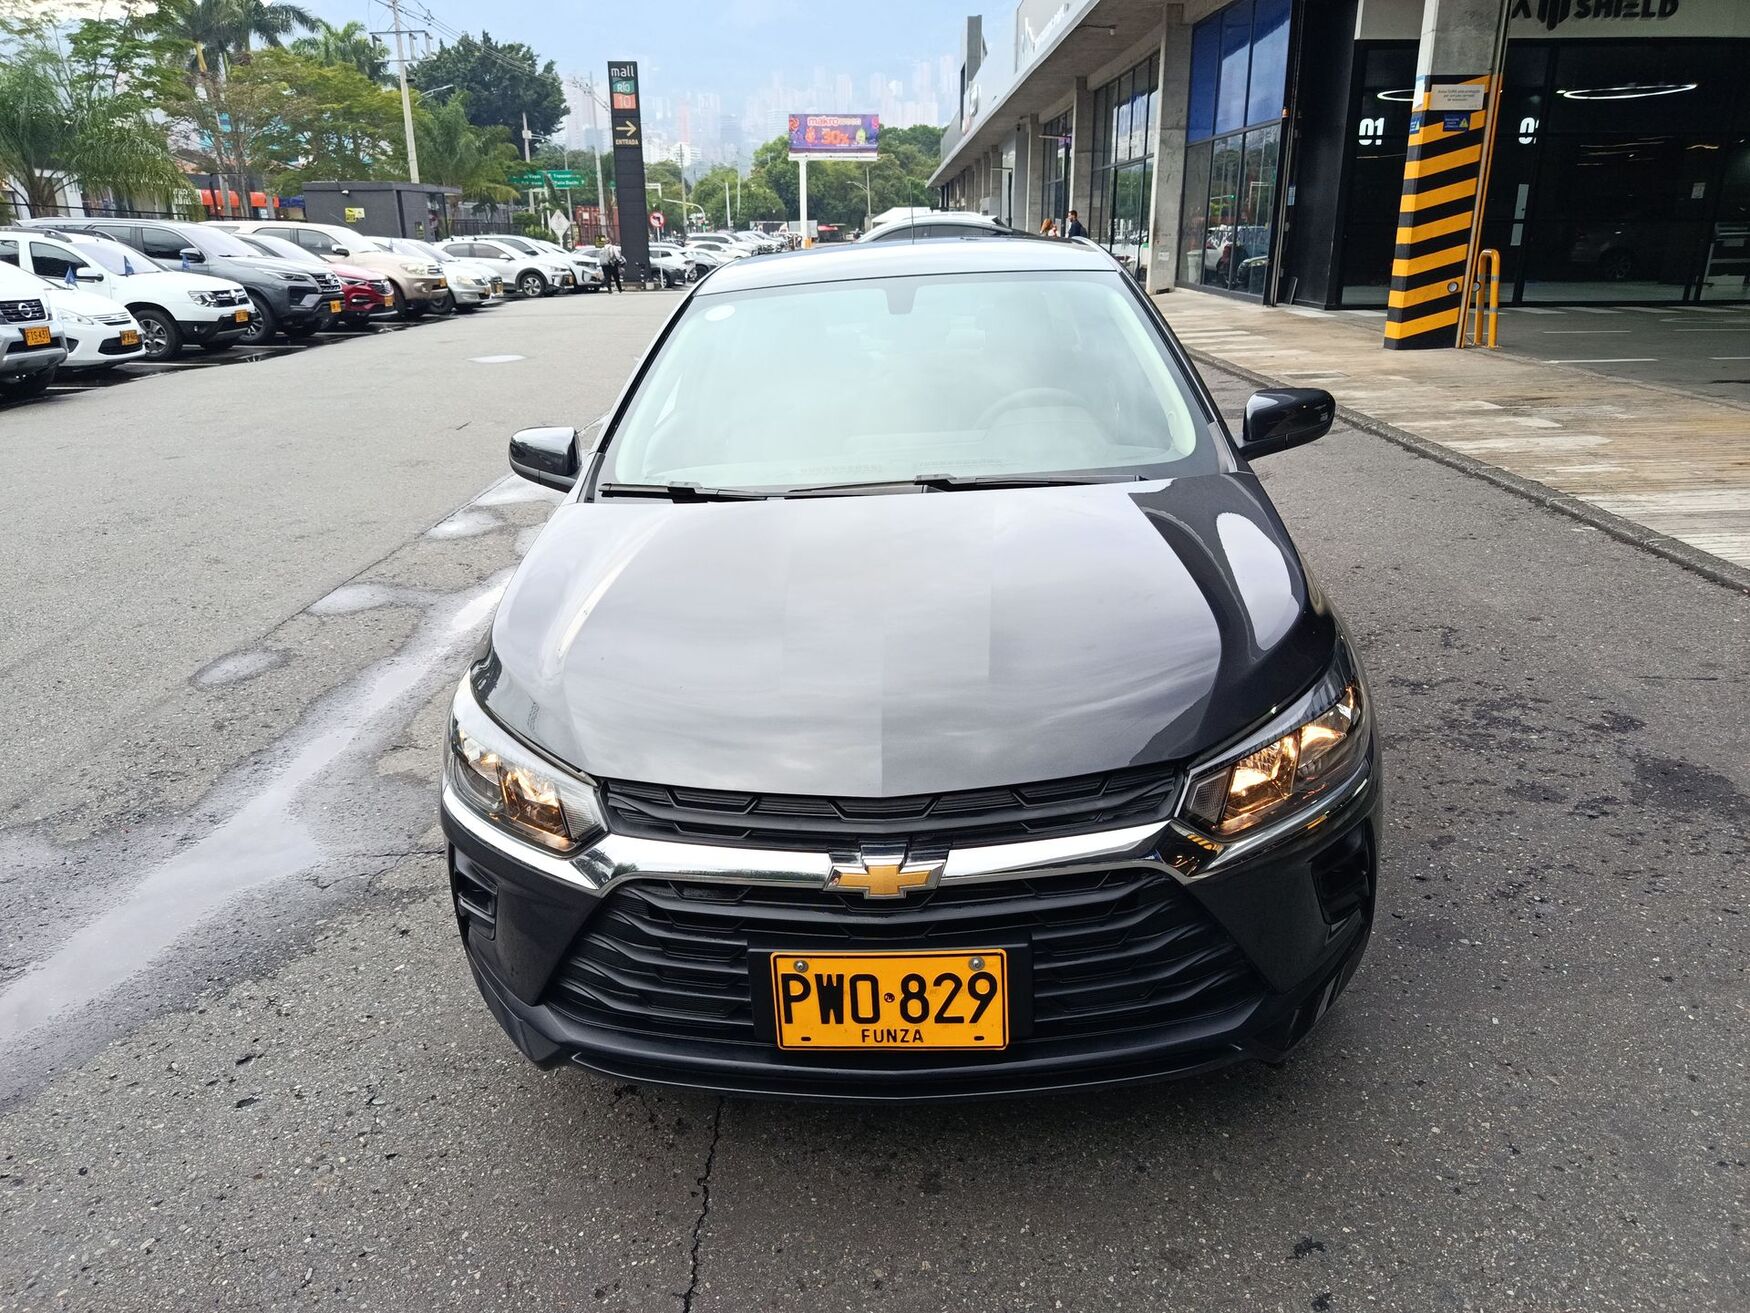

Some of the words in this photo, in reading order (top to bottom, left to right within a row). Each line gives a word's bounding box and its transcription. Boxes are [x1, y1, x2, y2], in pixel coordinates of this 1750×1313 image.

[1573, 0, 1679, 18] SHIELD
[611, 65, 635, 77] mall
[1358, 117, 1385, 146] 01
[861, 1028, 924, 1043] FUNZA
